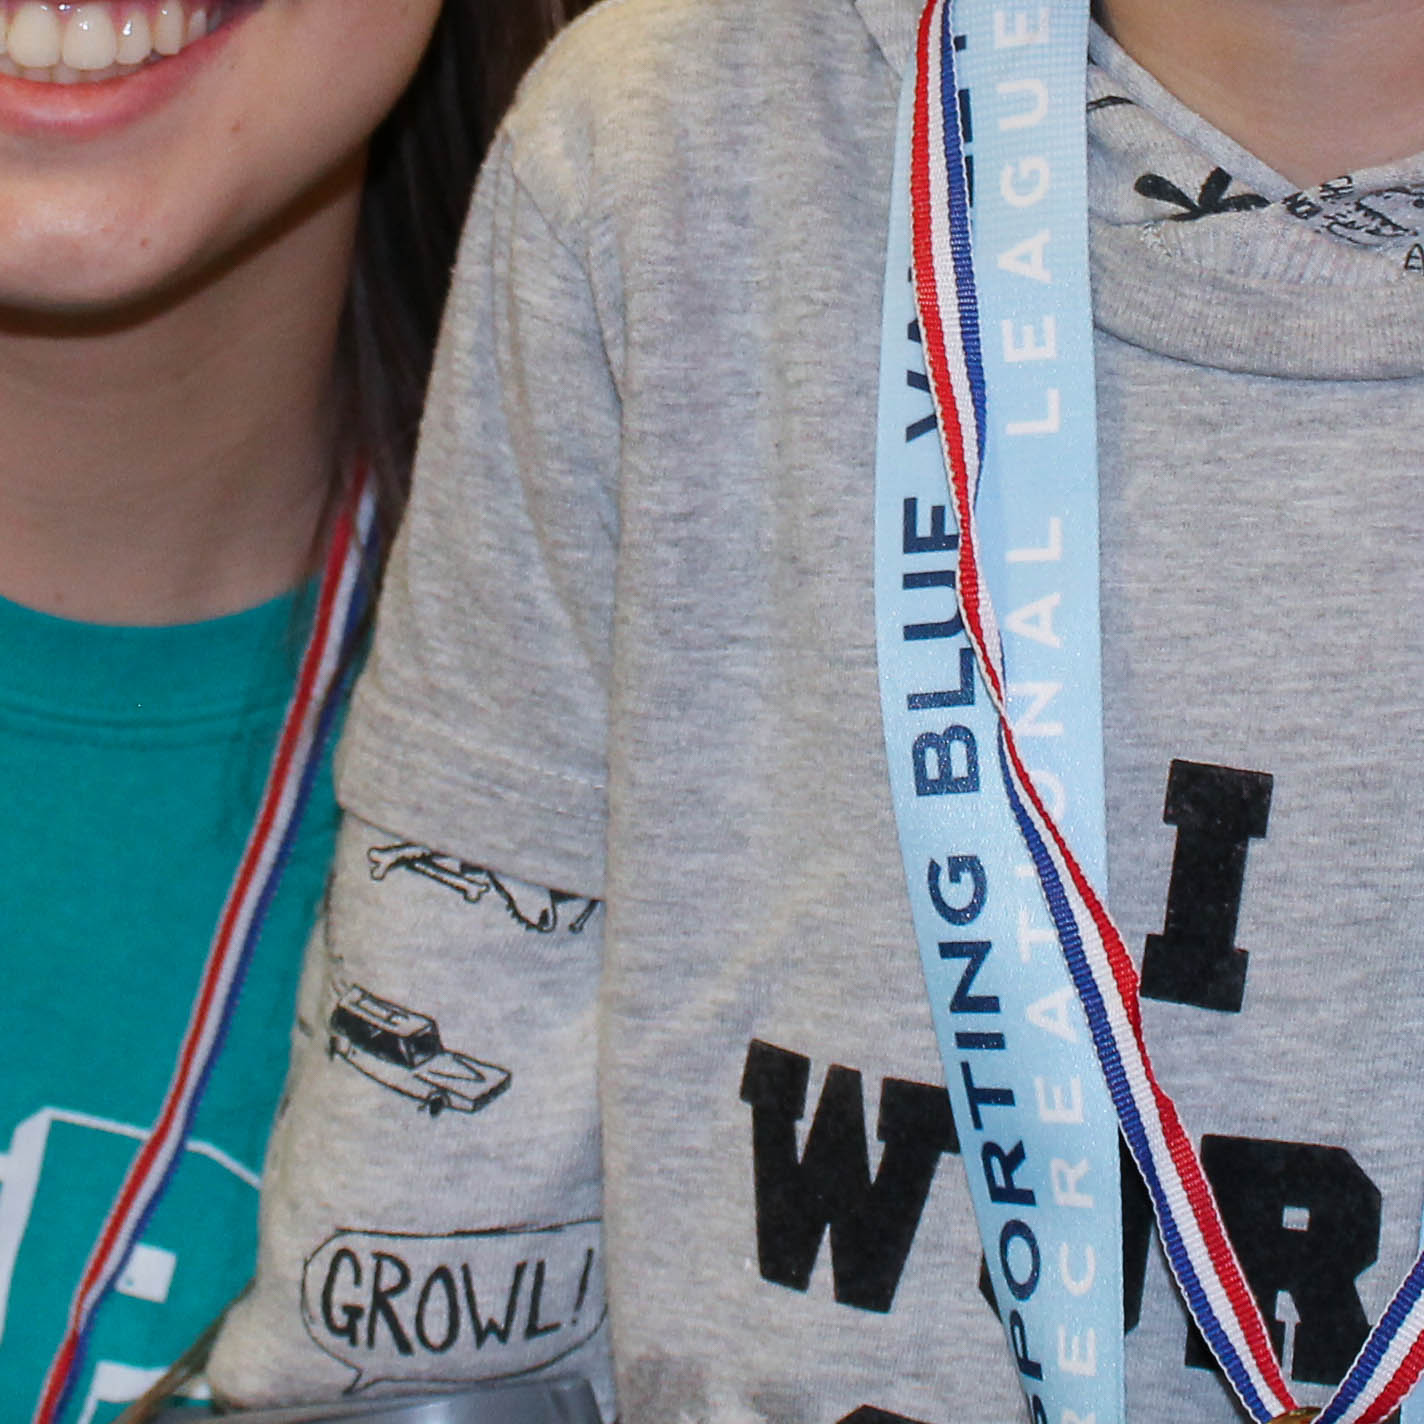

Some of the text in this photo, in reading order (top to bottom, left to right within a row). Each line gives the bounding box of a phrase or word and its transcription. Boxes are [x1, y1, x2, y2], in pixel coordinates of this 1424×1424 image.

[994, 8, 1063, 436] LEAGUE
[1140, 758, 1274, 1013] I
[321, 1248, 594, 1356] GROWL!
[927, 854, 1048, 1424] PORTING
